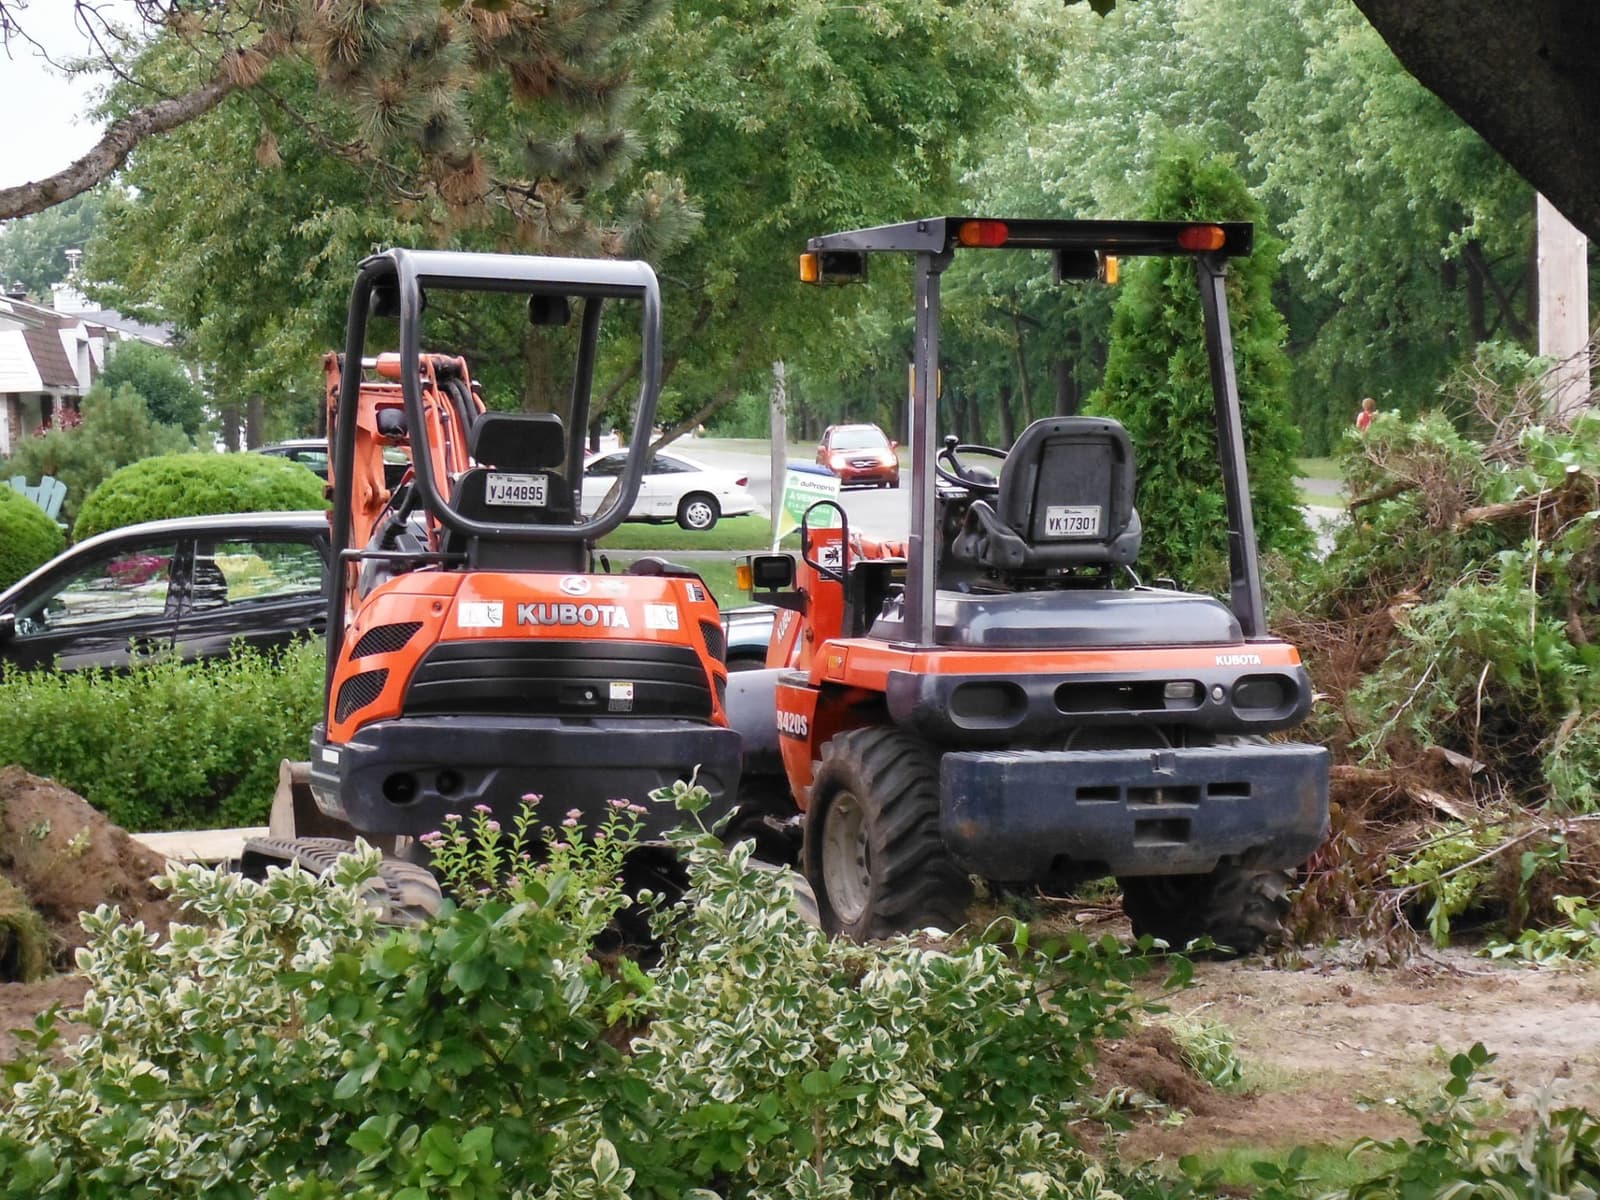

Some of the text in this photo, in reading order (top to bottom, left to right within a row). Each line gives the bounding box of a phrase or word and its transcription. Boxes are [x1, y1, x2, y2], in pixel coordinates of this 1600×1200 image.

[490, 485, 543, 500] VJ44895
[1049, 517, 1096, 531] VK17301
[517, 603, 629, 628] KUBOTA
[1215, 654, 1261, 666] KUBOTA
[776, 710, 808, 736] R420S
